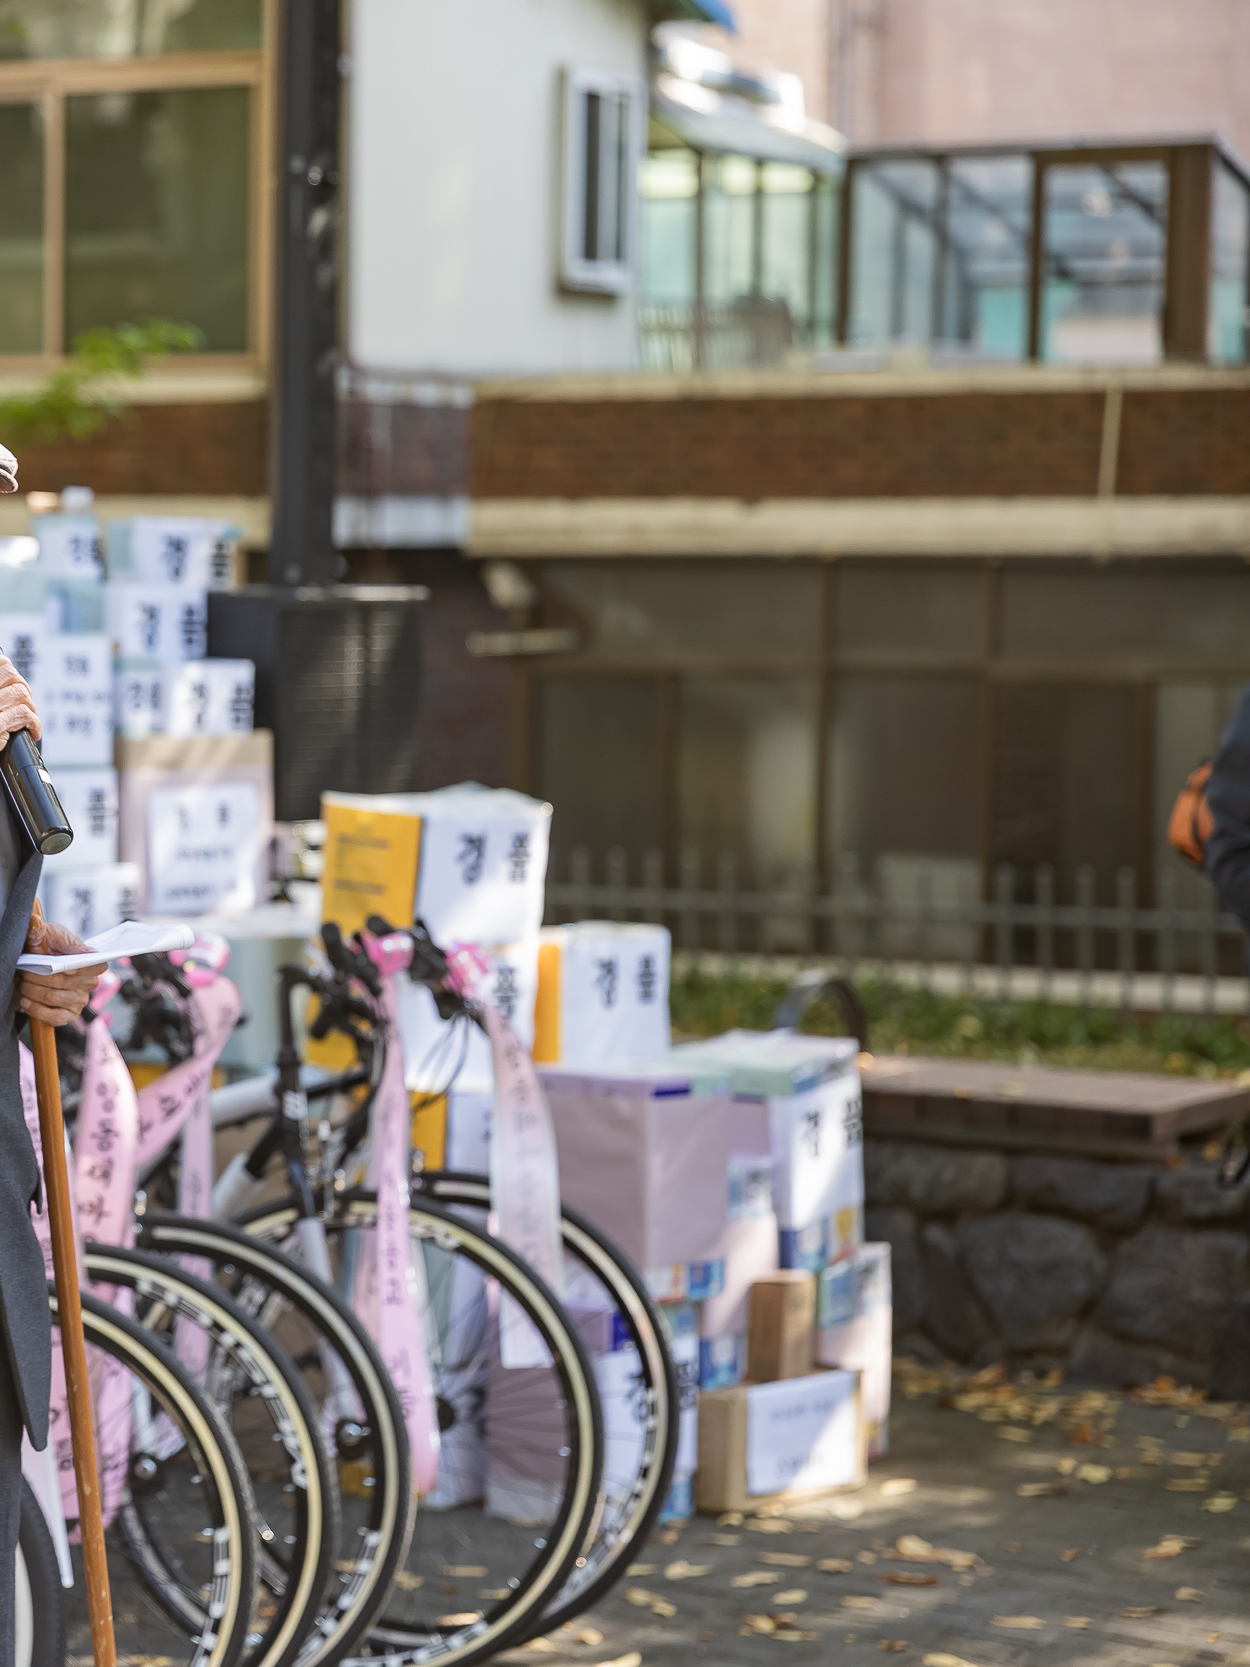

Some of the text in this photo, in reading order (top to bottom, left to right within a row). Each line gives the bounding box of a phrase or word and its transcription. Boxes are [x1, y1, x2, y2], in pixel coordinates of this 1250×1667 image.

[458, 832, 531, 885] 경 품
[597, 957, 618, 1009] 경
